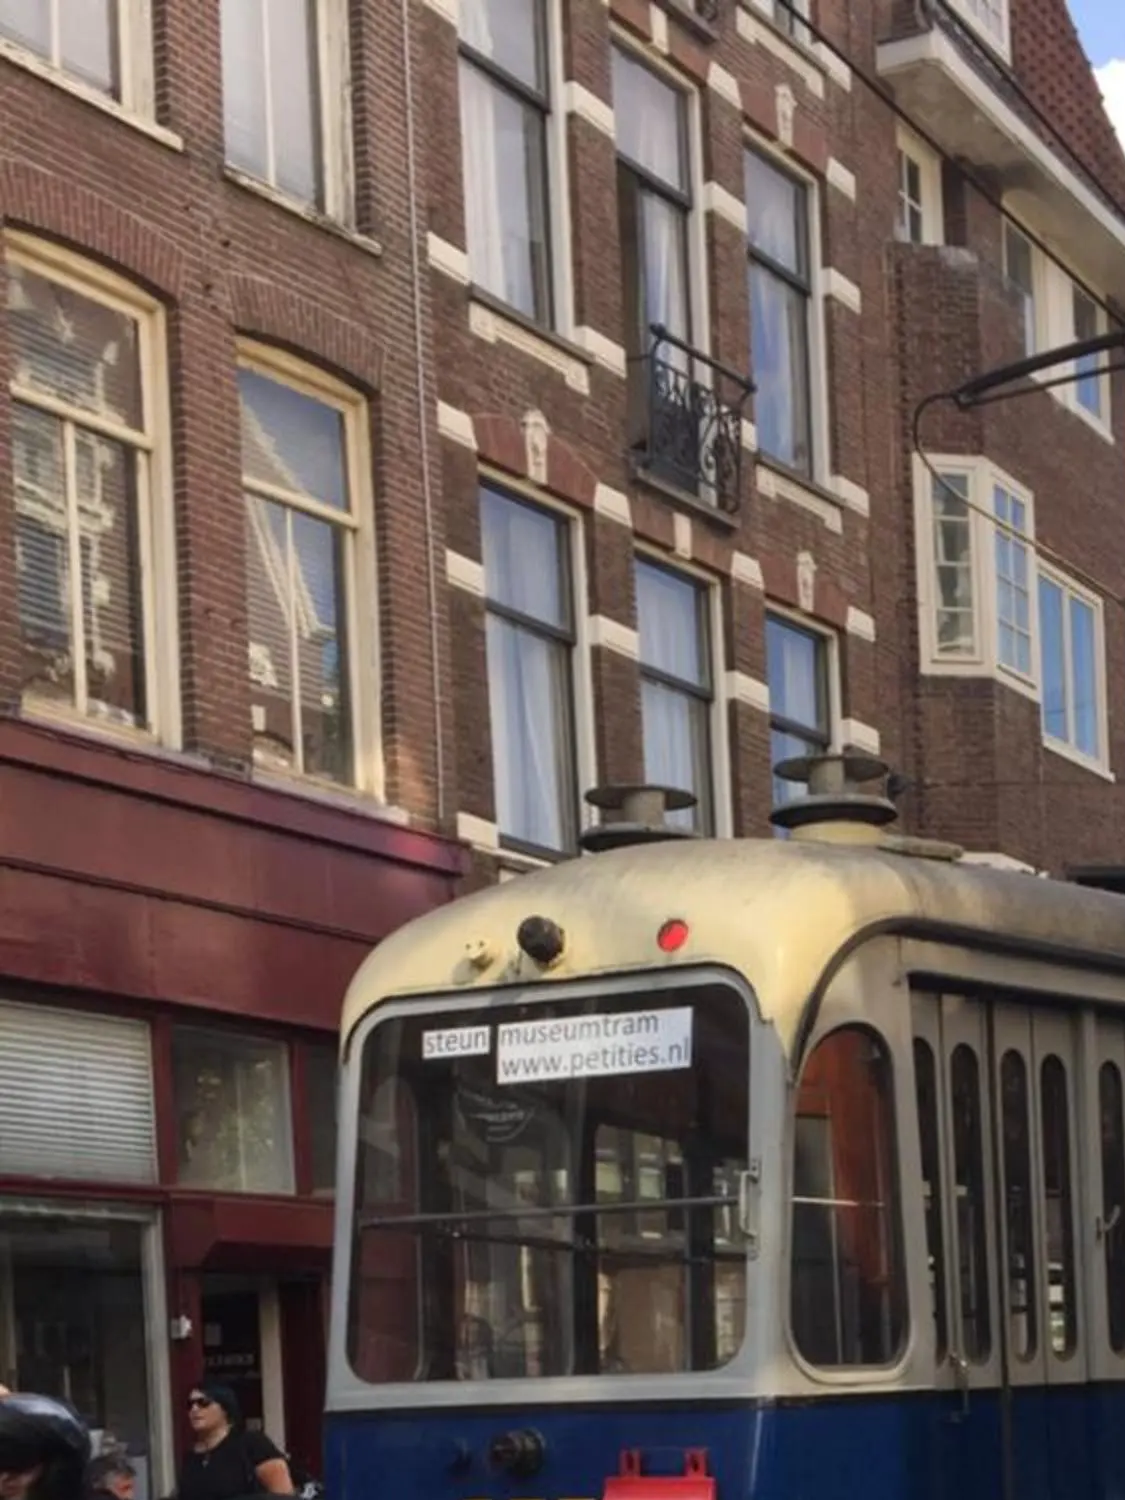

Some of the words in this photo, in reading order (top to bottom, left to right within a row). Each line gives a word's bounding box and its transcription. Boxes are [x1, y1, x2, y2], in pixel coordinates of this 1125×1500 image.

[425, 1031, 487, 1055] steun
[500, 1013, 659, 1047] museumtram
[502, 1037, 690, 1077] www.petities.nl
